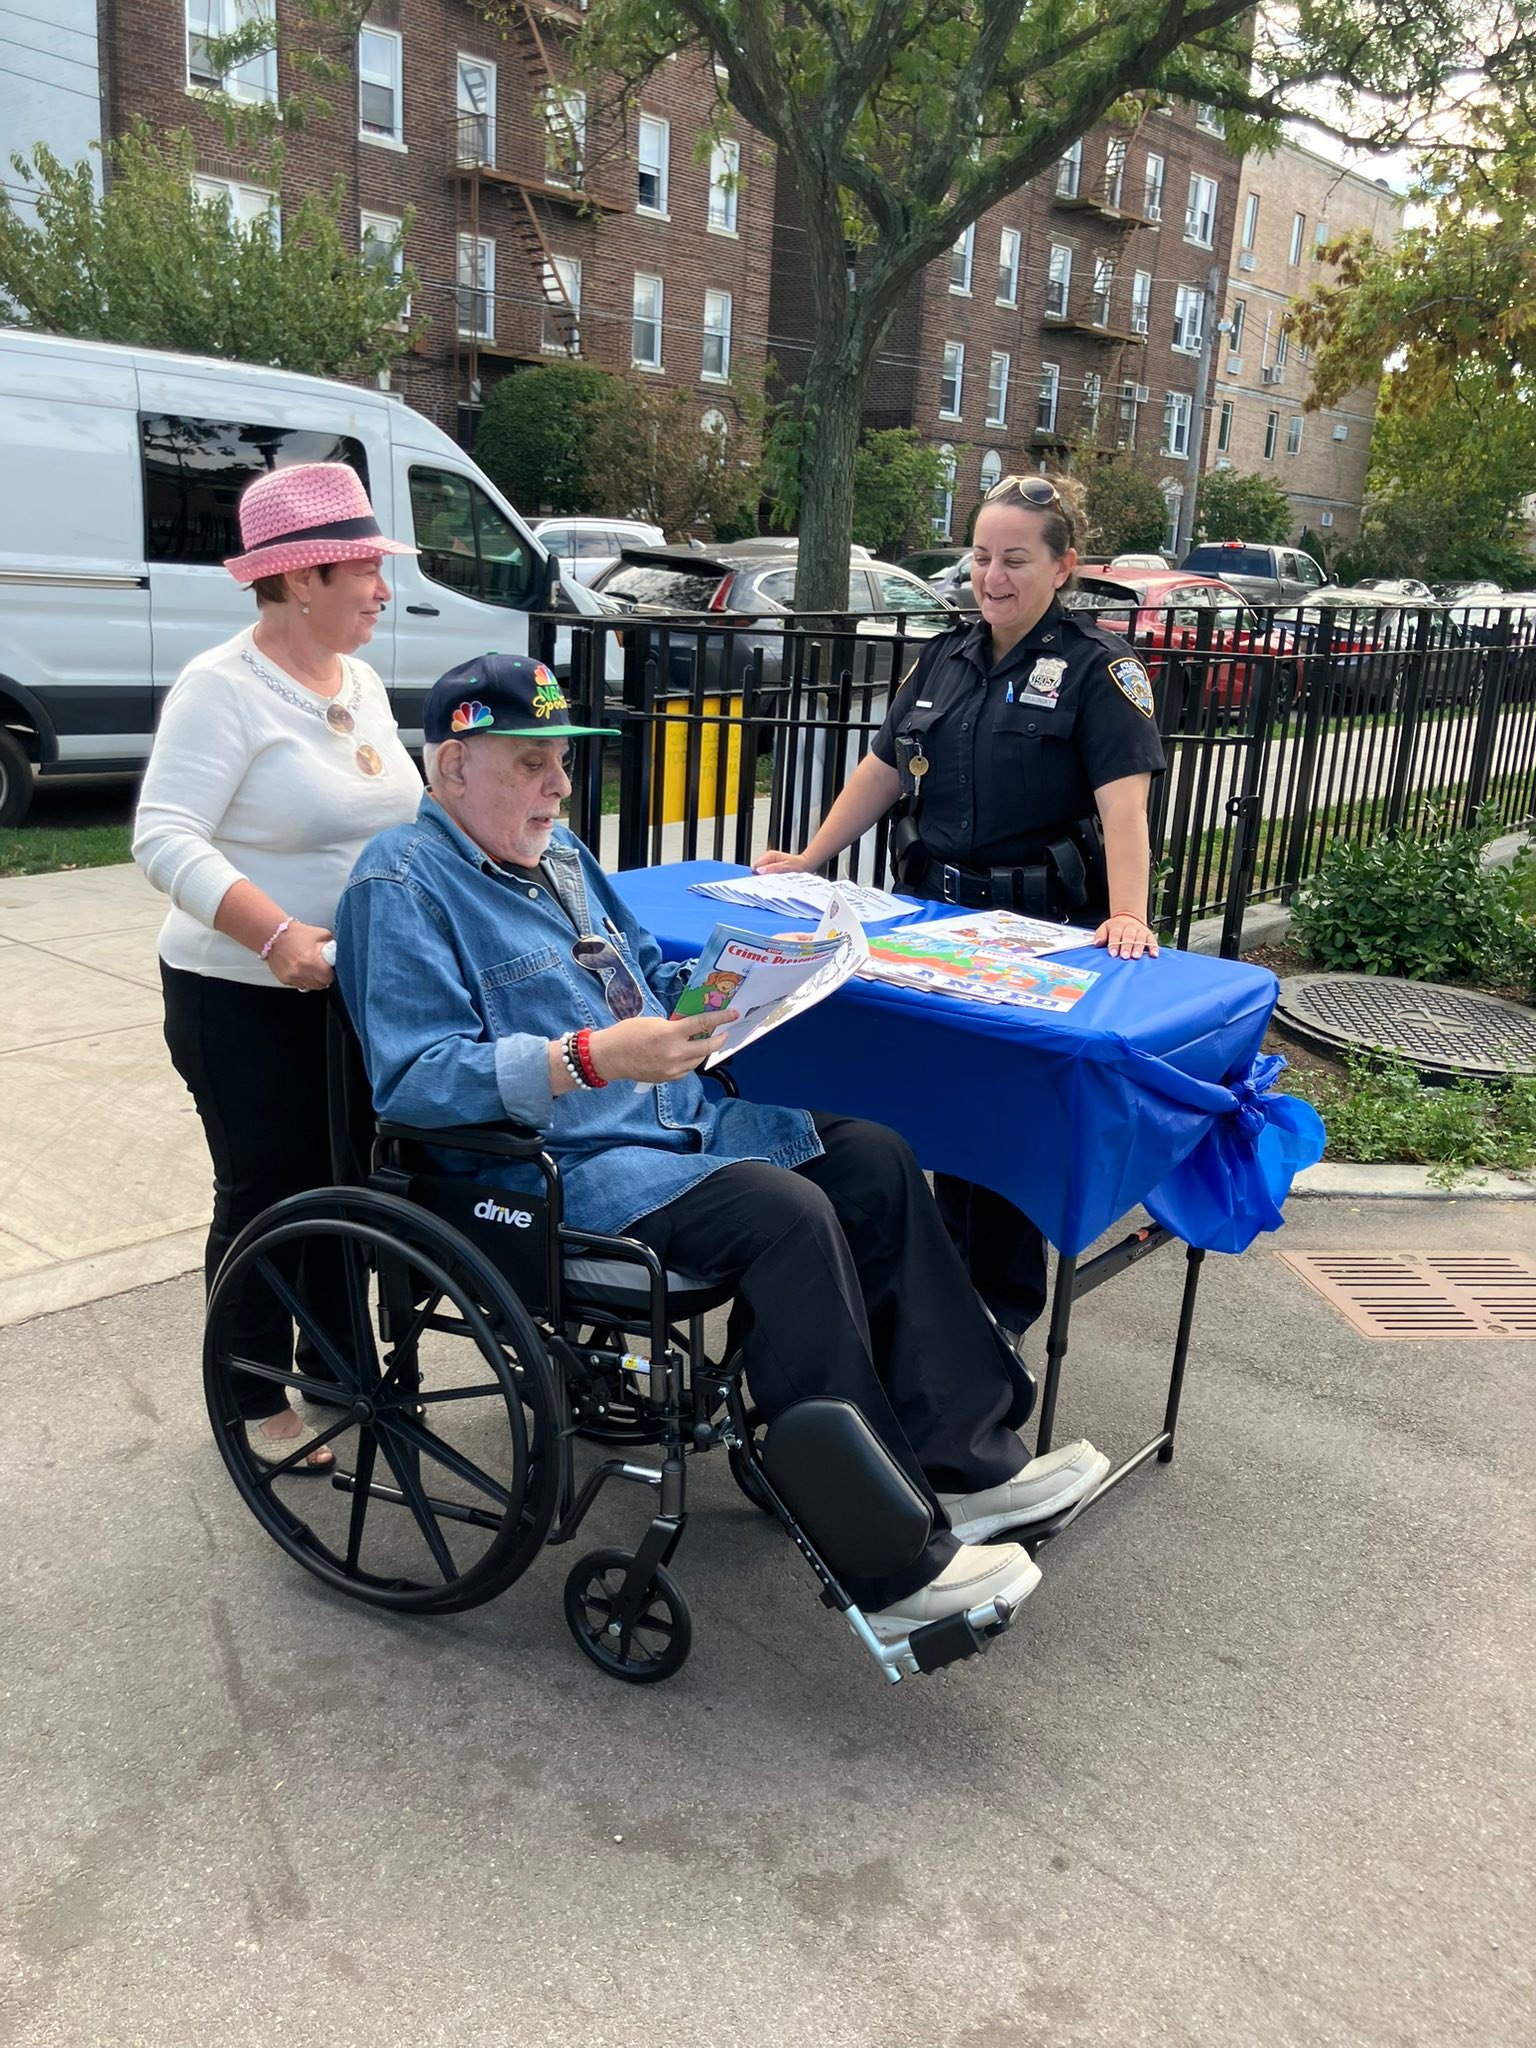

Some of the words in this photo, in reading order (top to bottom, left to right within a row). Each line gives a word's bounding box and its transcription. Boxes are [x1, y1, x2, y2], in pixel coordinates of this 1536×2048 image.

[536, 685, 561, 702] NB
[727, 944, 769, 963] Crime
[943, 977, 1059, 1008] NYPD
[473, 1198, 533, 1229] drive
